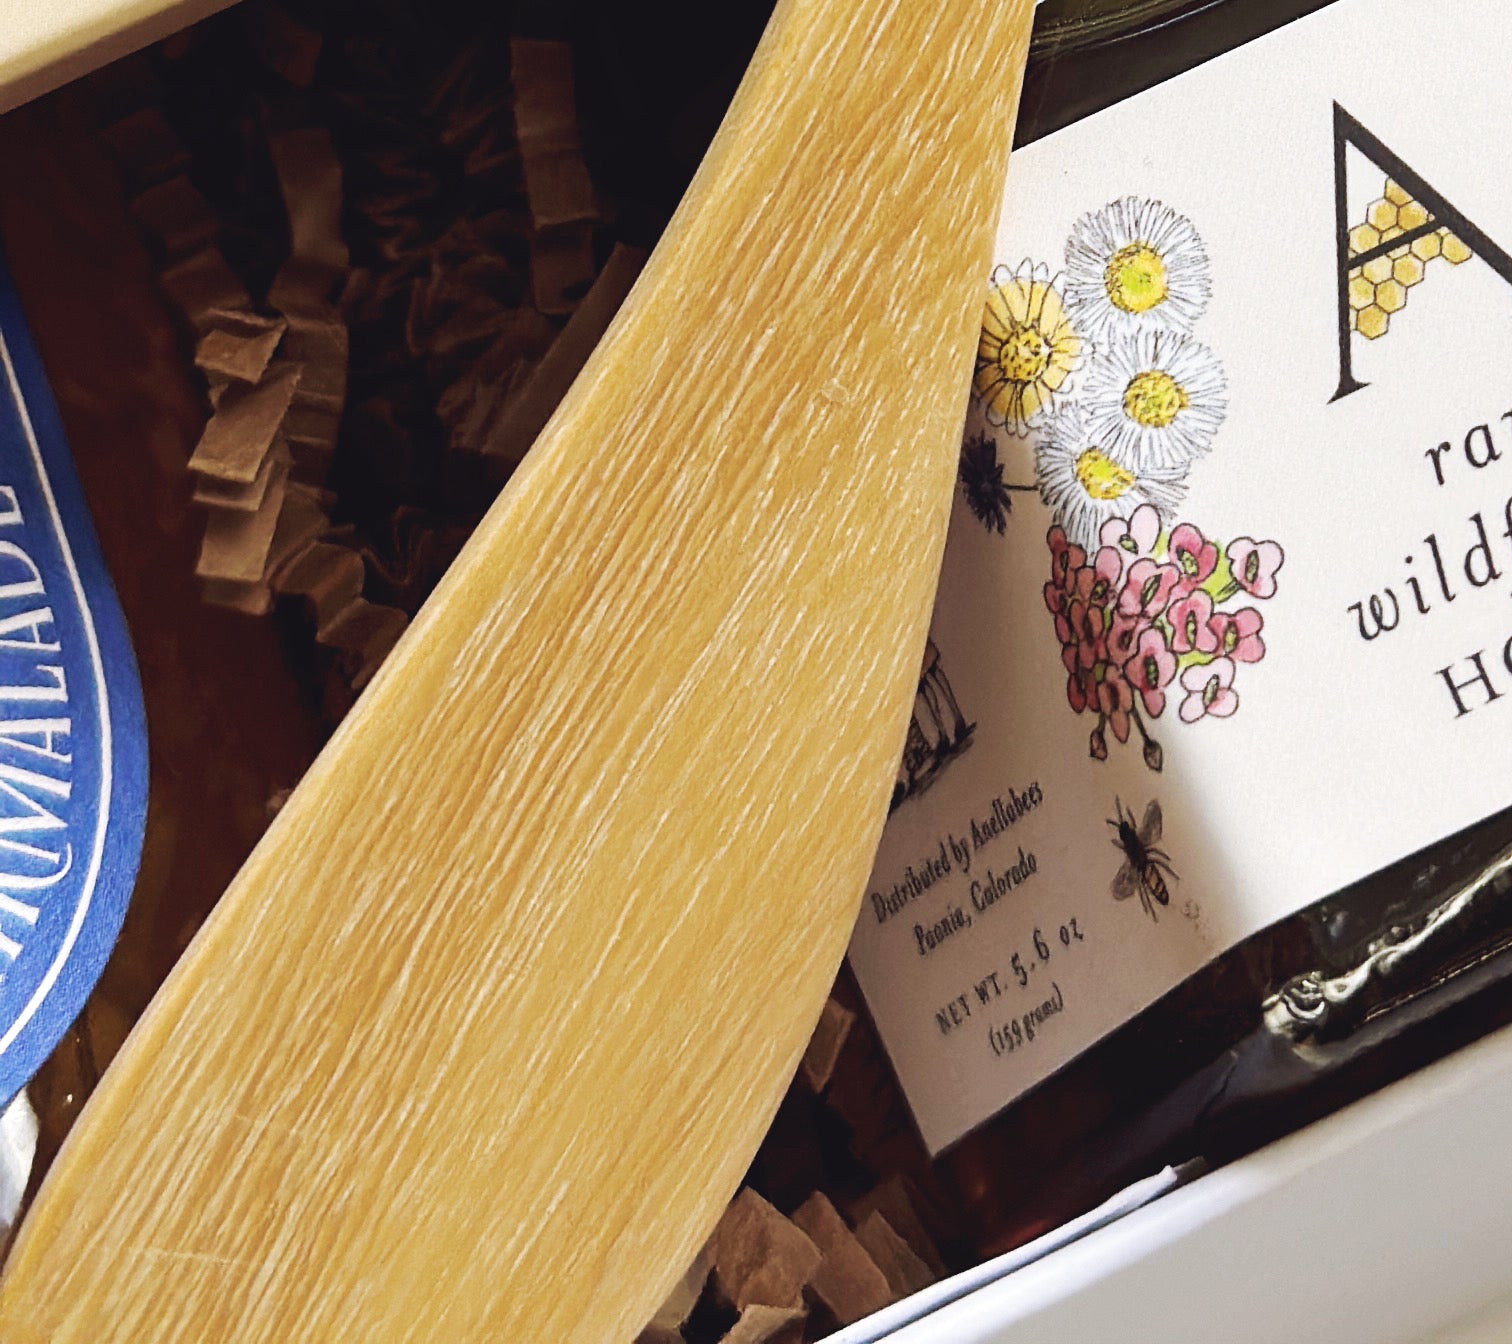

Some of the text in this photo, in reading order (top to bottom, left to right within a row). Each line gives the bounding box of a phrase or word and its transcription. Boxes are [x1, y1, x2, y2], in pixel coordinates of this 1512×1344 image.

[870, 780, 1044, 925] Distributed by Anellabees
[969, 846, 1038, 914] Colorado
[935, 993, 972, 1036] NET
[1058, 916, 1085, 947] oz
